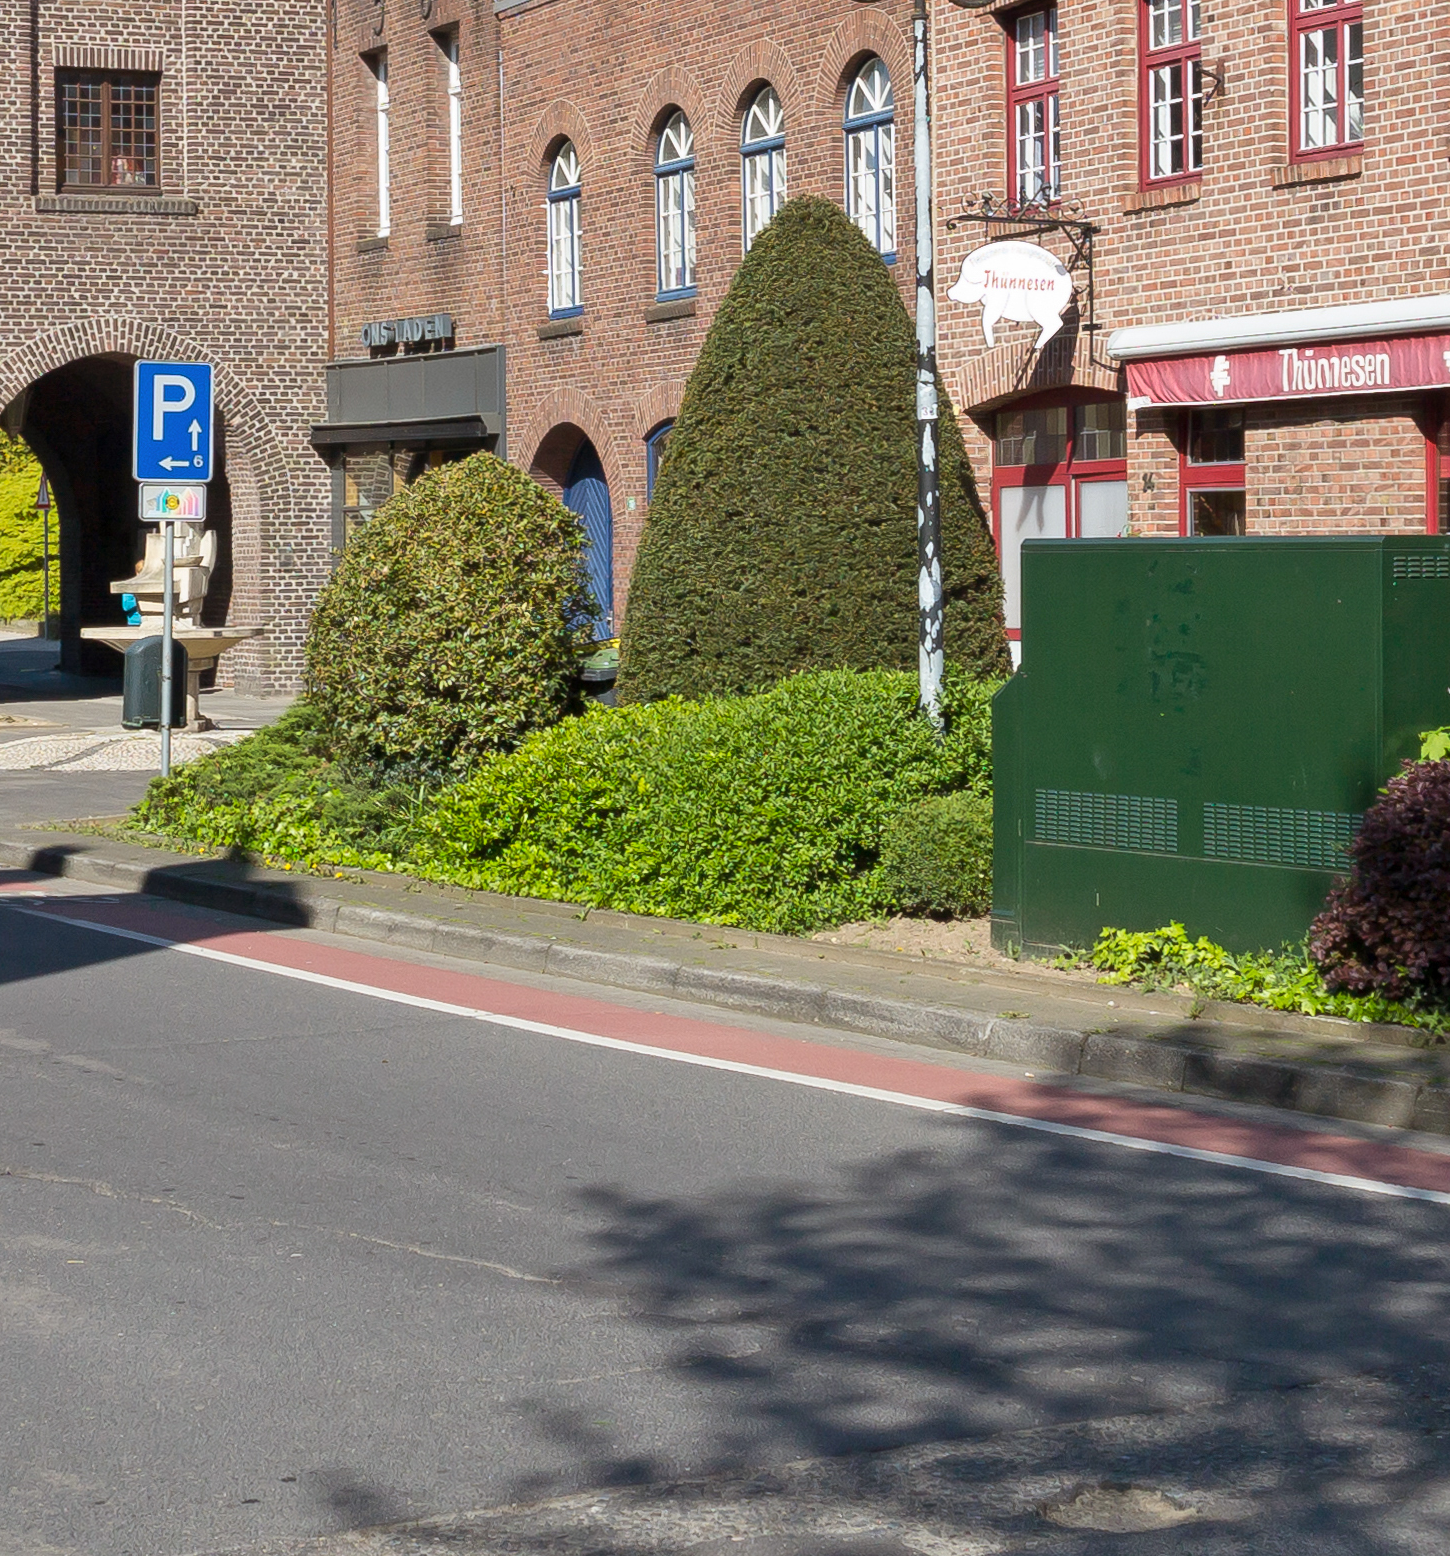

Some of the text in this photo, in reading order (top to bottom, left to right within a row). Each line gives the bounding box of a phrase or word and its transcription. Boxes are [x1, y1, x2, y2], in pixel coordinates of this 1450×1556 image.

[983, 269, 1055, 291] Thünnesen
[1279, 346, 1390, 392] Thünnesen
[152, 374, 196, 441] P
